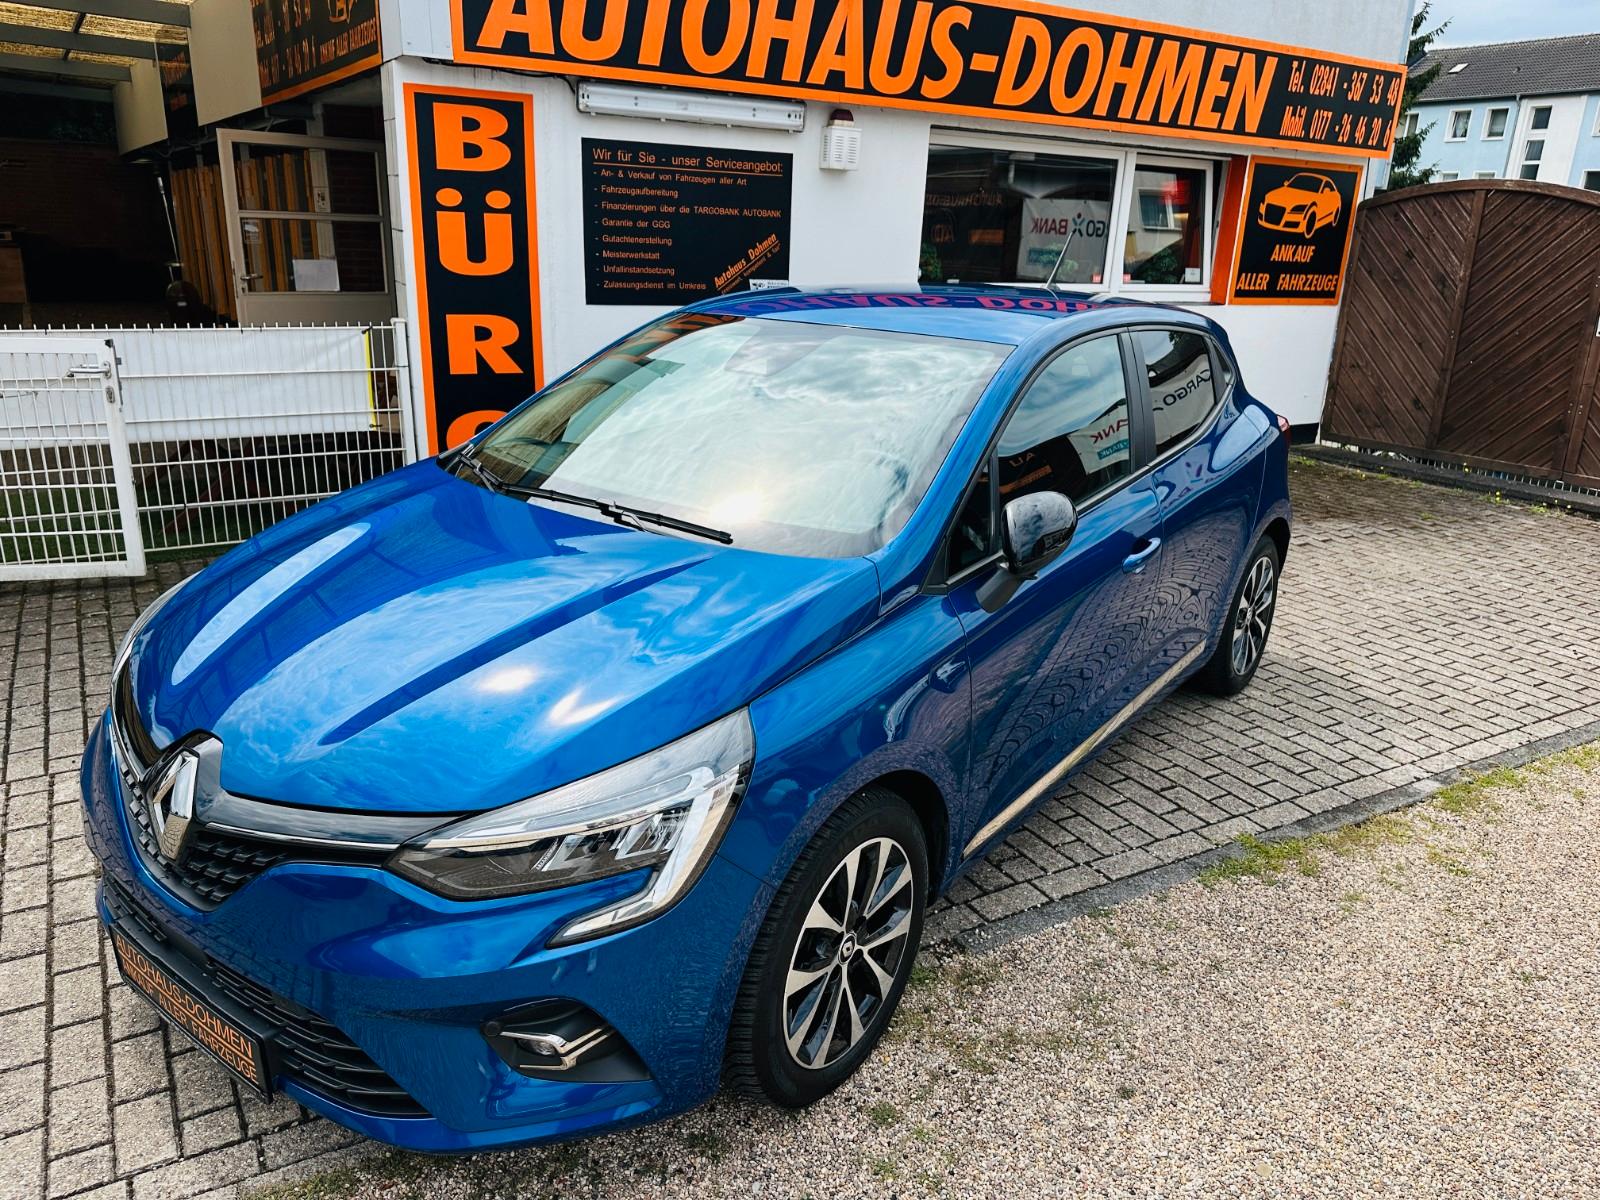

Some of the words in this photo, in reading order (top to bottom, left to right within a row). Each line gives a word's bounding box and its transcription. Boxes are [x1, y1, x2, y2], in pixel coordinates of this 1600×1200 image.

[1288, 60, 1306, 93] Tel.
[1309, 63, 1340, 98] 02841
[1369, 74, 1384, 104] 53
[1387, 77, 1400, 106] 48
[1280, 105, 1307, 138] Mobil.
[1309, 108, 1333, 140] 0177
[1355, 115, 1368, 145] 46
[1368, 117, 1382, 147] 20
[1383, 120, 1392, 148] 6
[593, 148, 611, 160] Wir
[618, 150, 632, 161] für
[639, 152, 656, 163] Sie
[672, 156, 700, 167] unser
[706, 156, 783, 173] Serviceangebot:
[618, 170, 624, 178] &
[628, 170, 655, 180] Verkauf
[676, 174, 715, 184] Fahrzeugen
[737, 178, 747, 186] Art
[601, 185, 678, 198] Fahrzeugaufbereitung
[601, 202, 656, 213] Finanzierungen
[660, 204, 676, 213] über
[680, 206, 690, 214] die
[694, 206, 740, 216] TARGOBANK
[742, 209, 781, 218] AUTOBANK
[602, 218, 633, 227] Garantie
[636, 220, 648, 228] der
[652, 220, 670, 229] GGG
[602, 234, 672, 246] Gutachtenerstellung
[602, 250, 660, 260] Meisterwerkstatt
[714, 258, 746, 289] Autohaus
[748, 233, 777, 260] Dohmen
[1270, 244, 1316, 263] ANKAUF
[603, 265, 675, 276] Unfallinstandsetzung
[1236, 272, 1270, 291] ALLER
[1276, 273, 1338, 291] FAHRZEUGE
[116, 934, 253, 1059] AUTOHAUS-DOHMEN
[122, 958, 154, 997] ANKAUF
[159, 995, 188, 1028] ALLER
[191, 1021, 259, 1085] FAHRZEUGE
